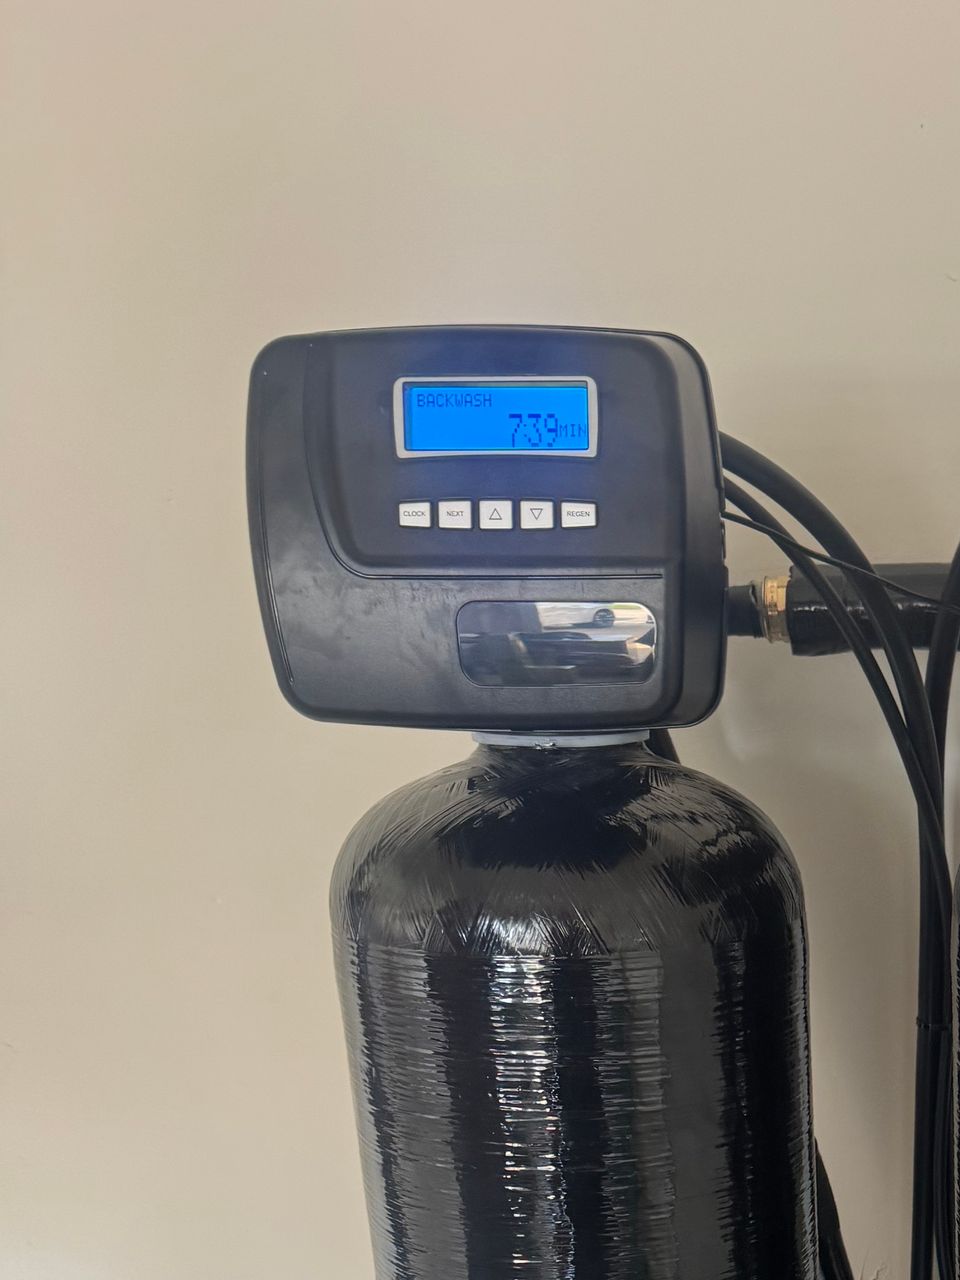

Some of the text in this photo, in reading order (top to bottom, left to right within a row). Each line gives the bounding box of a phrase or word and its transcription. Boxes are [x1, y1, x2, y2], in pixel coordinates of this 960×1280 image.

[417, 393, 492, 407] BACKWASH
[559, 423, 587, 438] MIN
[566, 510, 590, 518] REGEN
